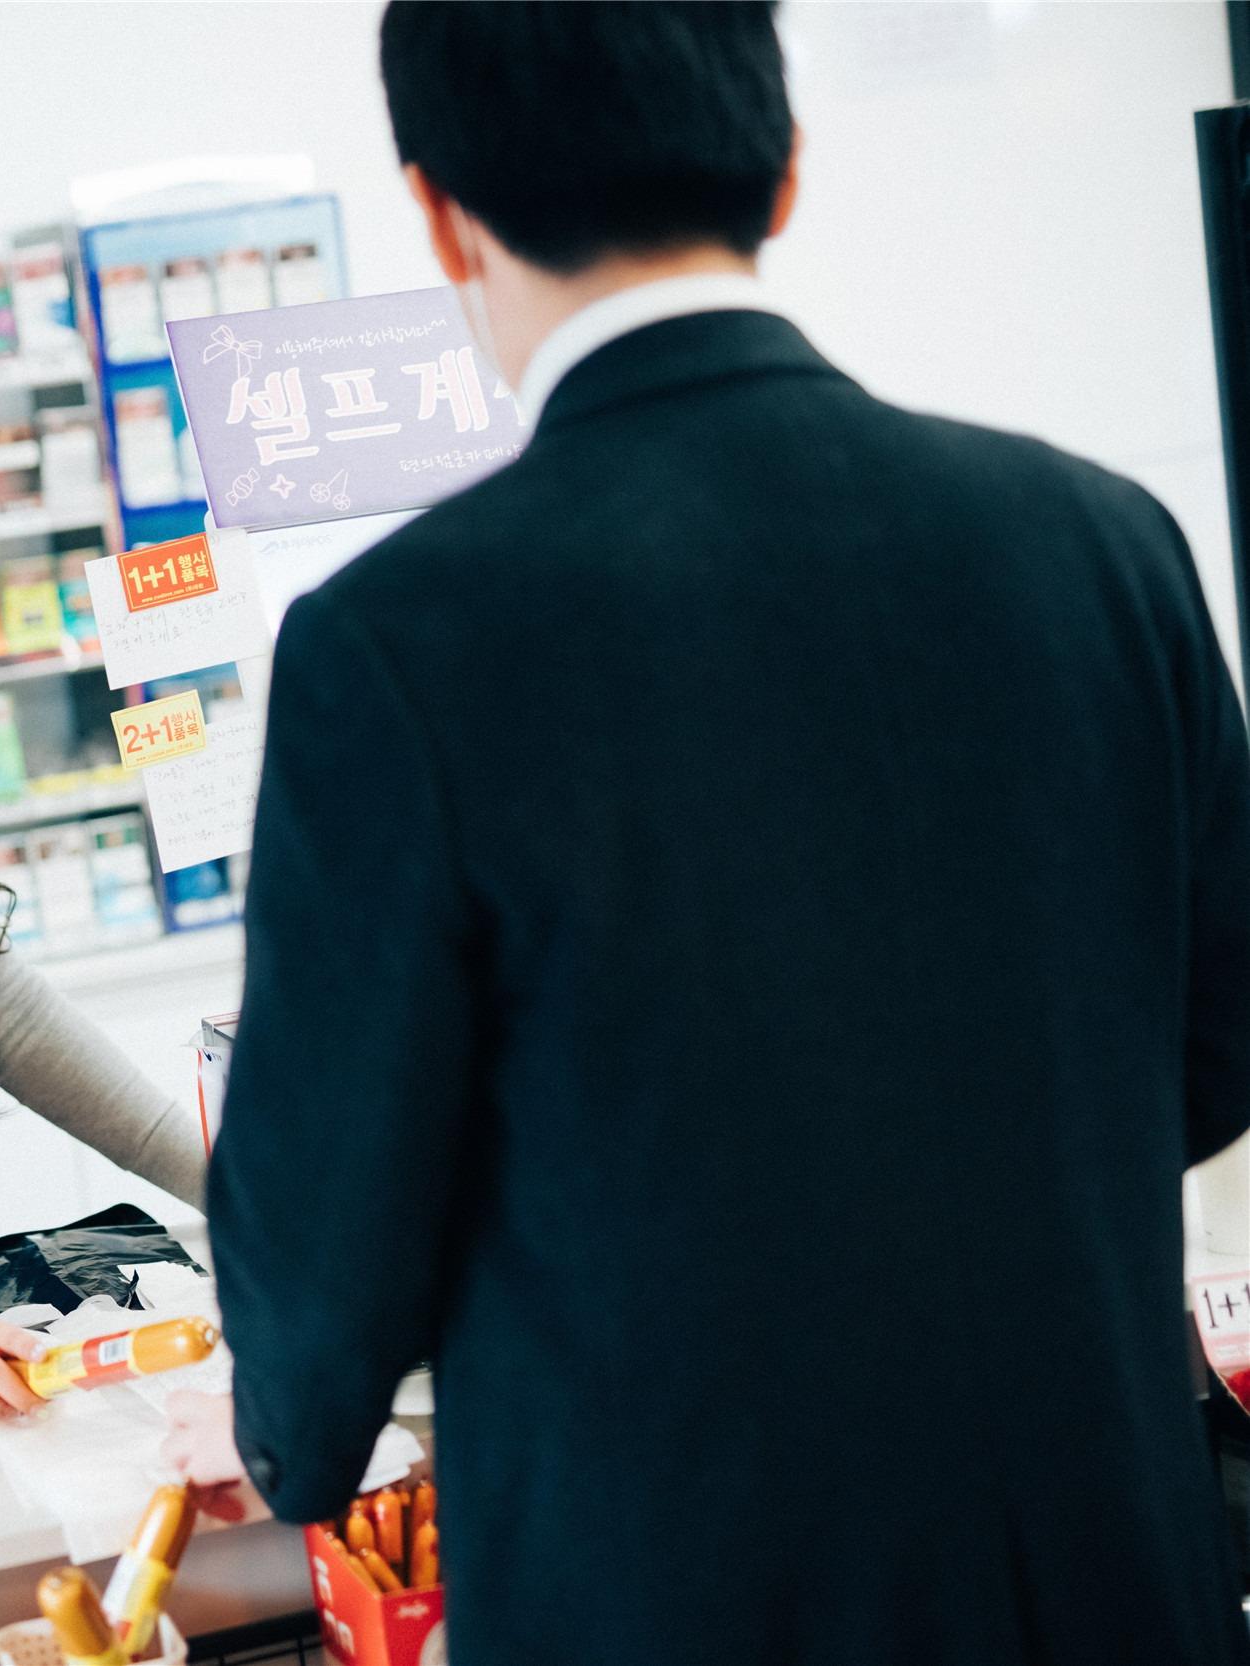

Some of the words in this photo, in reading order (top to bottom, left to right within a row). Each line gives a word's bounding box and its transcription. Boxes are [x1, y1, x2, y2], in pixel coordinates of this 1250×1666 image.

[225, 346, 527, 466] 셀프계
[177, 550, 207, 569] 행사
[127, 557, 179, 595] 1+1
[180, 565, 210, 583] 품목
[170, 710, 197, 727] 행사
[122, 714, 175, 754] 2+1
[173, 722, 200, 742] 품목
